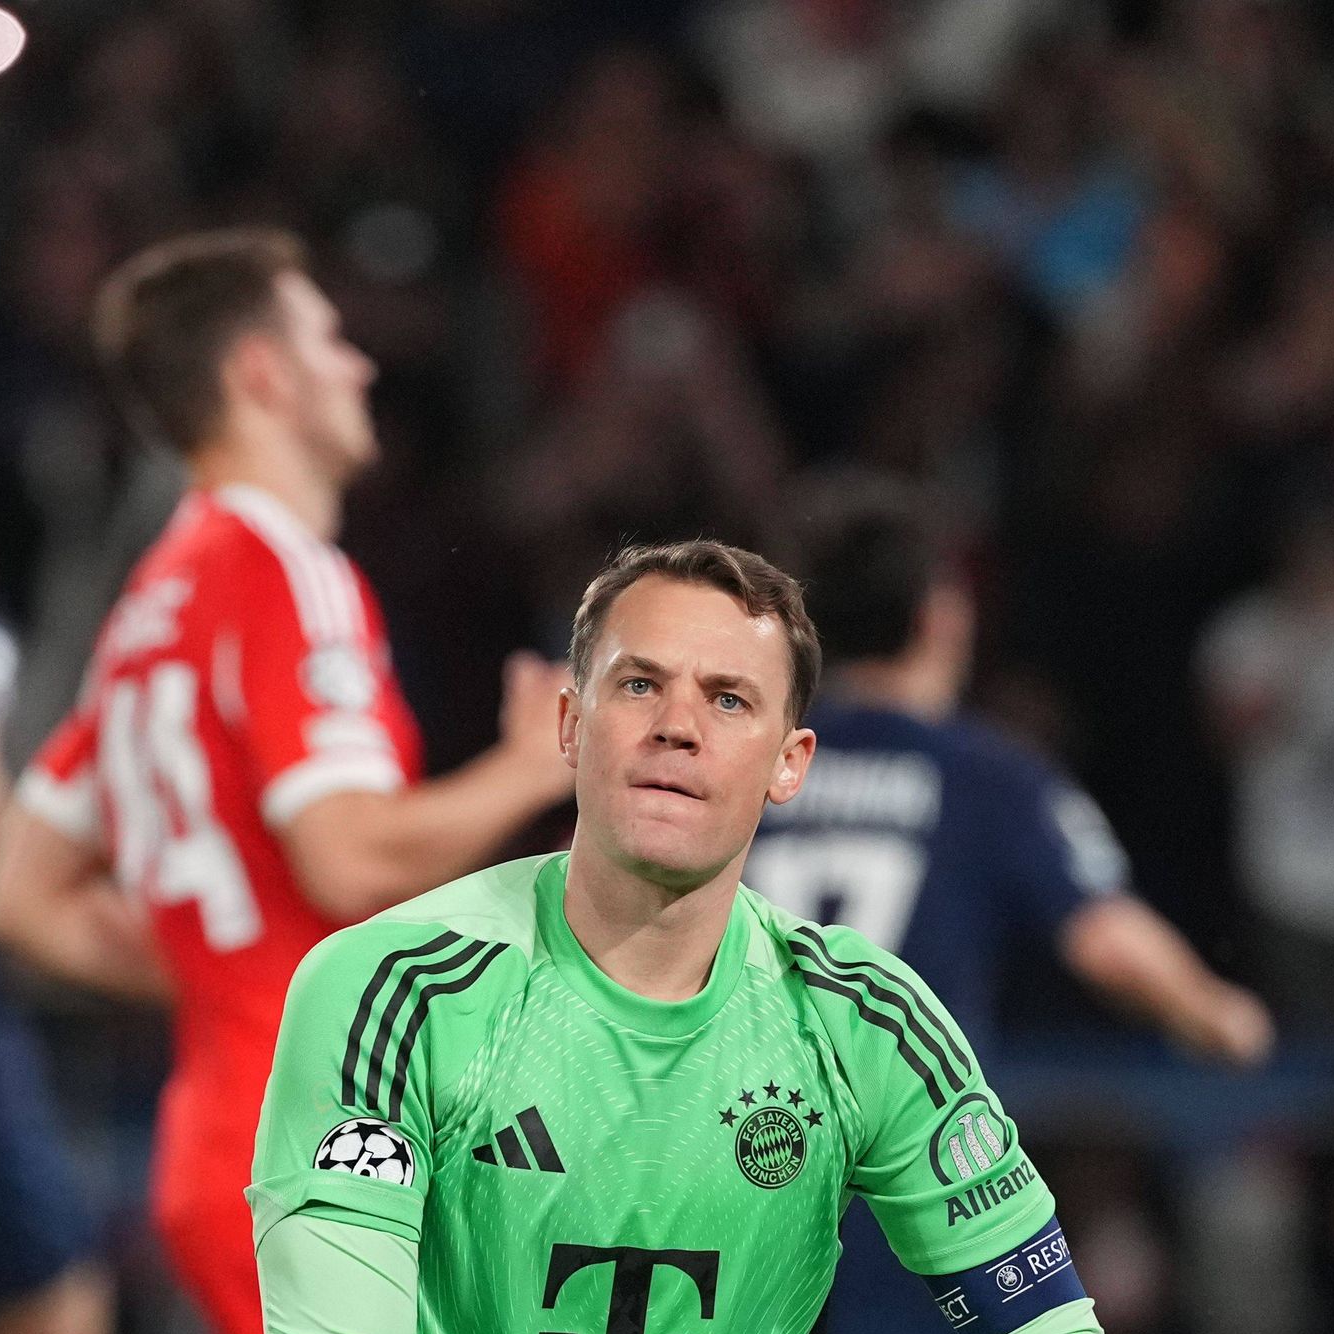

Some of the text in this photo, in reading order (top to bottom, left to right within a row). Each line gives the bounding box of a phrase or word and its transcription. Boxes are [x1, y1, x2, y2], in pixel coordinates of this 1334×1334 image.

[742, 1112, 802, 1143] FC BAYERN
[945, 1160, 1036, 1227] Allianz
